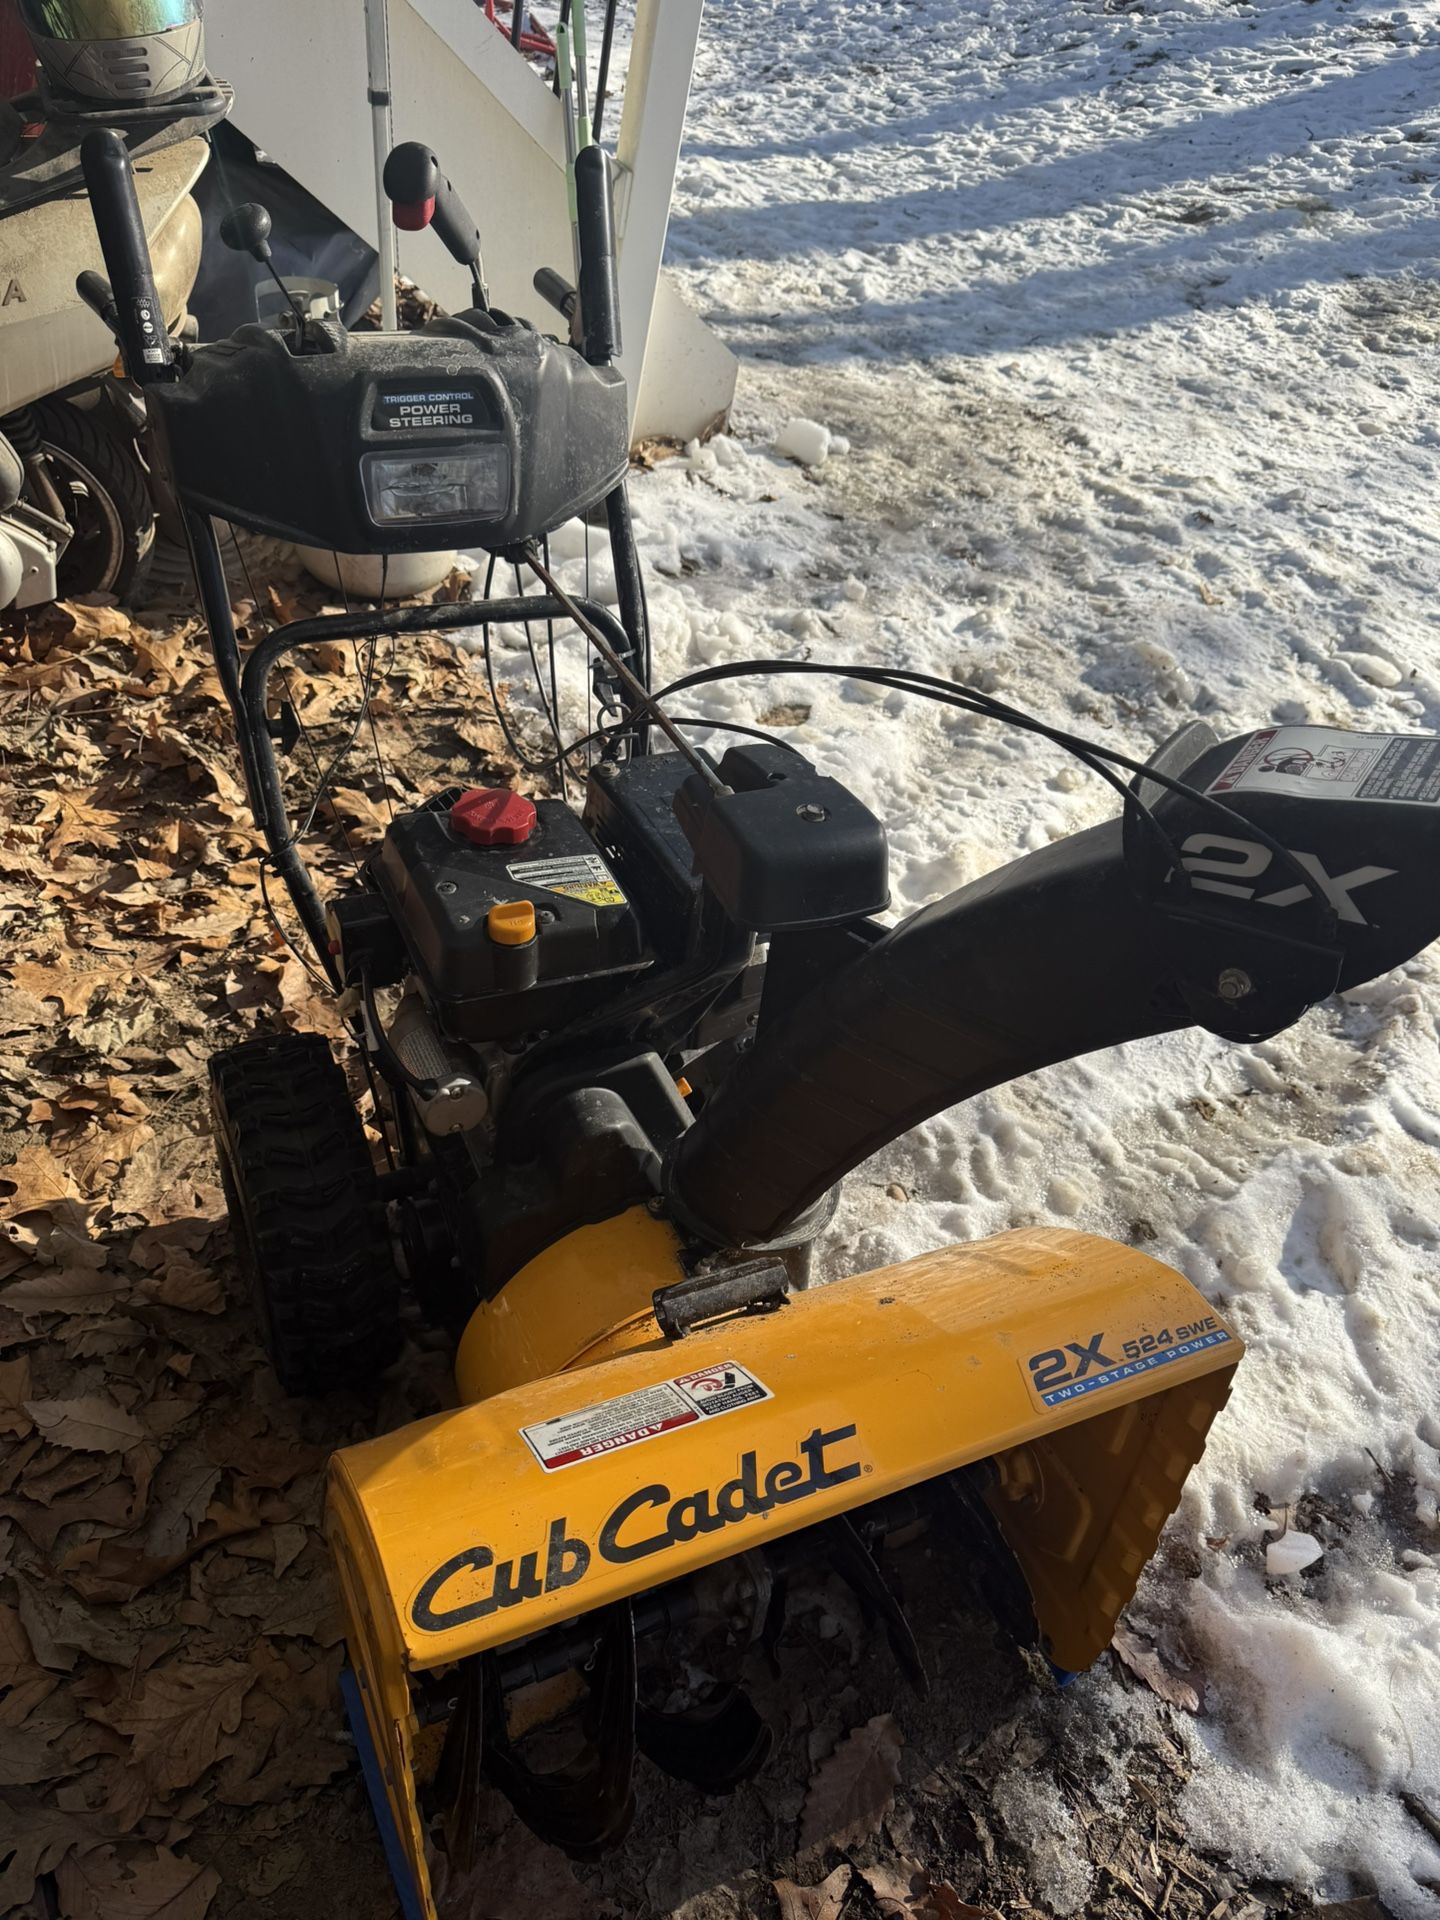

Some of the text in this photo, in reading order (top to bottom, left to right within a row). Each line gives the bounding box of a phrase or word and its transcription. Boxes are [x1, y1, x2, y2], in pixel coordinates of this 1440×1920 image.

[2, 279, 27, 306] A
[384, 392, 474, 404] TRIGGER CONTROL
[400, 403, 460, 415] POWER
[389, 414, 473, 427] STEERING
[1164, 833, 1399, 925] 2X
[1028, 1317, 1217, 1392] 2X 524 SWE
[1045, 1332, 1228, 1402] TWO-STAGE POWER
[690, 1363, 733, 1380] DANGER
[580, 1430, 650, 1456] DANGER
[411, 1424, 861, 1632] Cub Cadet
